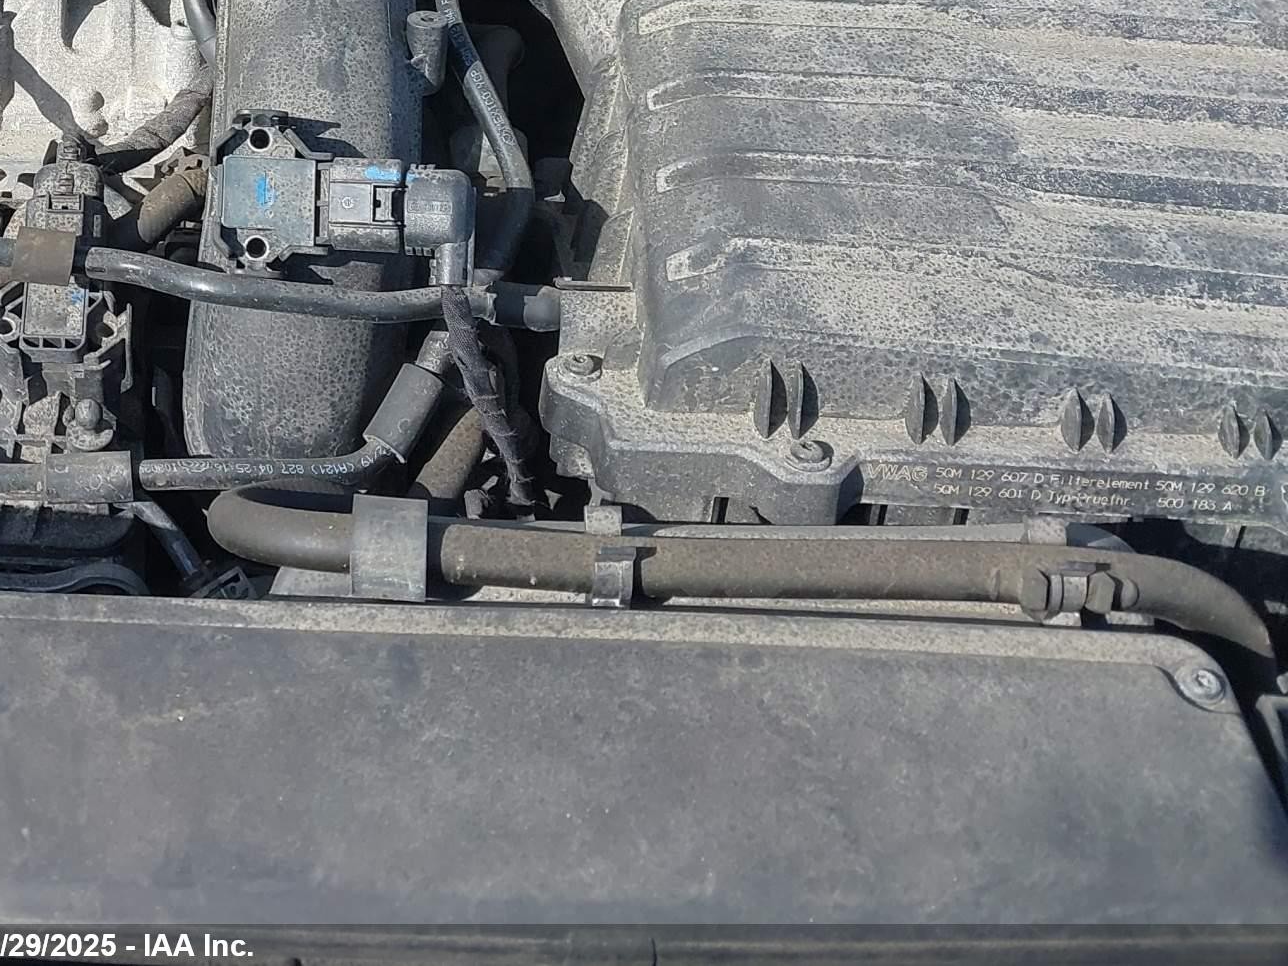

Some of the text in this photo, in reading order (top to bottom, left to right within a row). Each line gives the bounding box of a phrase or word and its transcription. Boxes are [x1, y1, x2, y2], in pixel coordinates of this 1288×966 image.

[280, 462, 305, 474] 827
[867, 464, 928, 482] VWAG
[971, 469, 995, 481] 129
[1001, 472, 1028, 483] 607
[1033, 474, 1044, 483] D
[1049, 474, 1150, 491] Filterelement
[1191, 482, 1216, 494] 129
[1221, 485, 1249, 496] 620
[1254, 485, 1266, 497] B
[968, 486, 992, 497] 129
[998, 488, 1023, 499] 601
[1030, 490, 1042, 500] D
[1192, 499, 1216, 511] 183
[1221, 500, 1233, 511] A
